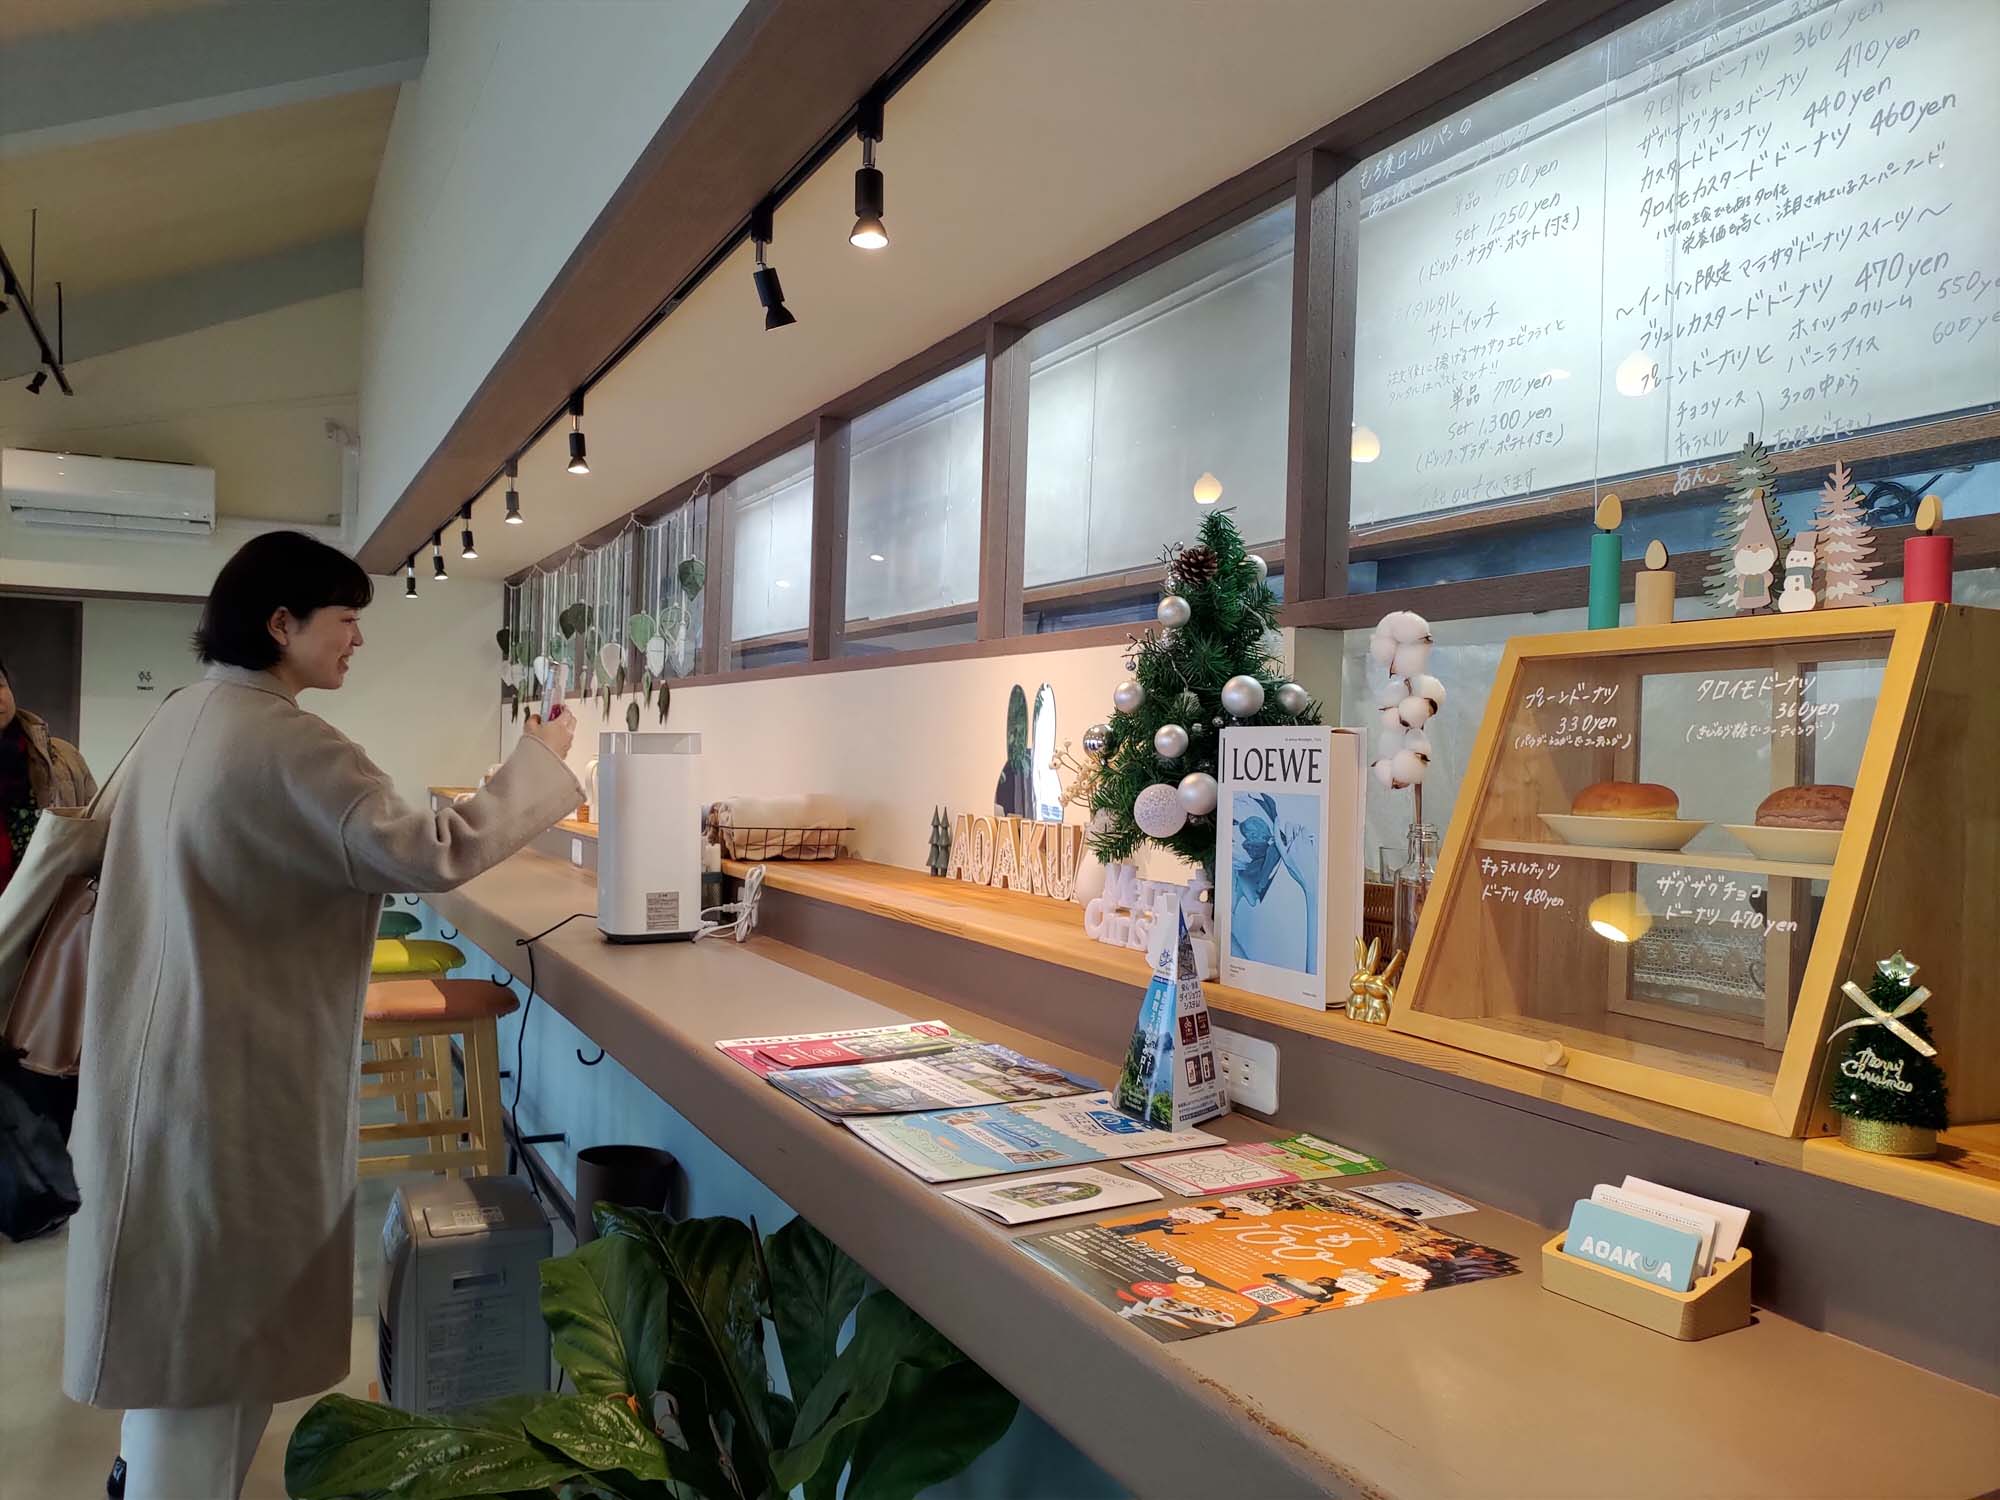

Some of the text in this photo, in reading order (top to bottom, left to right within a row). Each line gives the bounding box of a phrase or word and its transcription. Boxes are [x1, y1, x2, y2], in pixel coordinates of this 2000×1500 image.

[1792, 22, 1832, 55] 360
[1839, 1, 1884, 40] yen
[1640, 121, 1773, 192] カスタードドーナツ
[1525, 684, 1620, 709] プレーンドーナツ
[1696, 672, 1817, 703] タロイモドーナツ
[1232, 748, 1322, 783] LOEWE
[1664, 904, 1721, 925] ドーナツ
